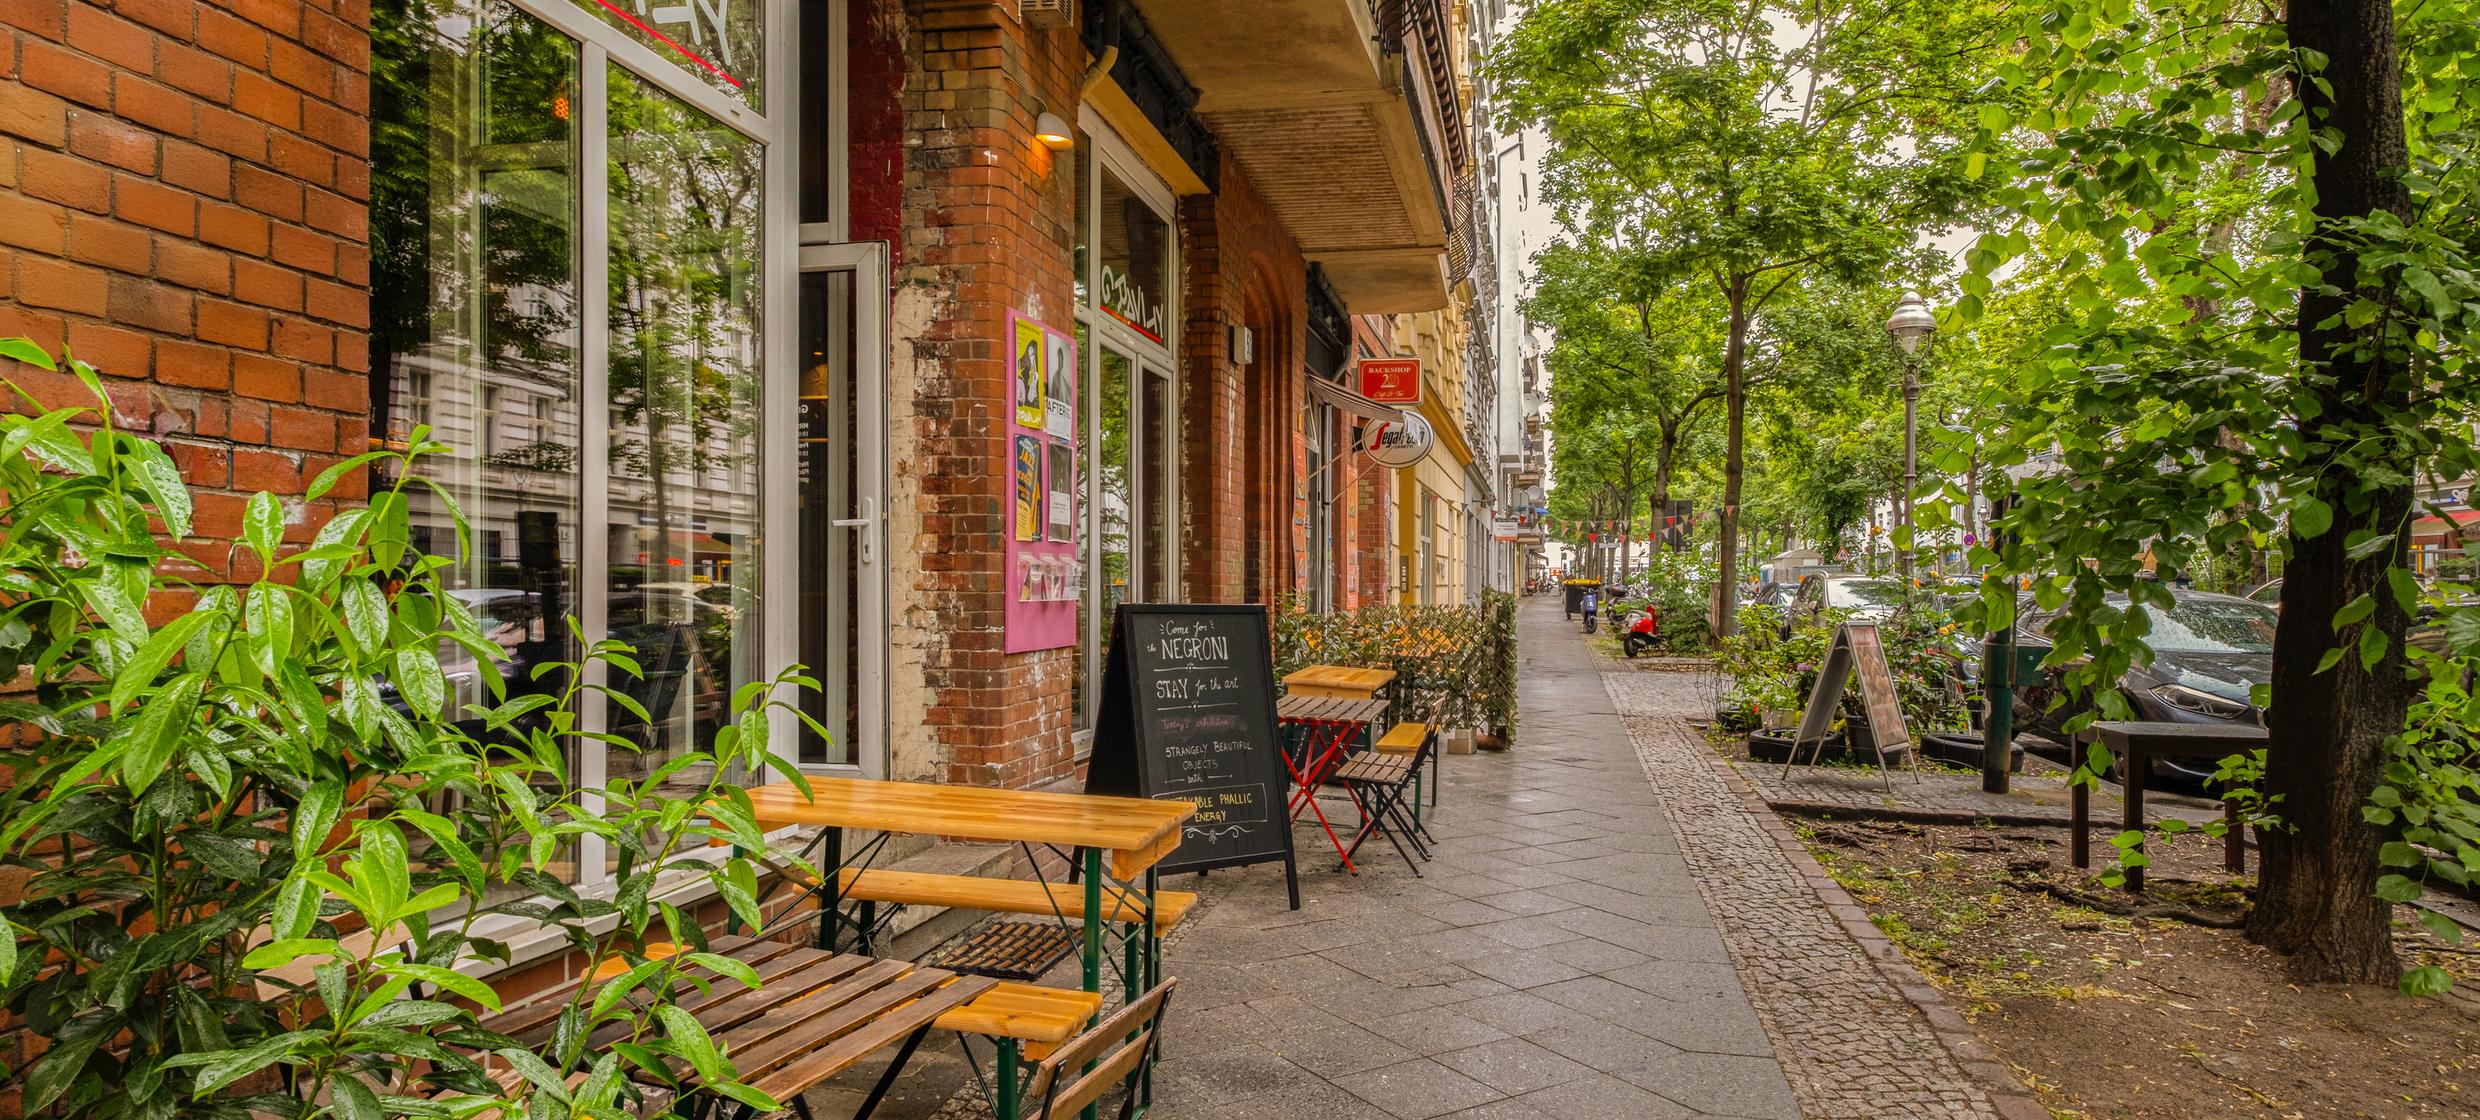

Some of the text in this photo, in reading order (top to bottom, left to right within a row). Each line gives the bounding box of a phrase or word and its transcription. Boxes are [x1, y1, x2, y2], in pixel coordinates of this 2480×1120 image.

[1166, 620, 1208, 637] Come for
[1147, 636, 1229, 661] the NEGRONI
[1156, 677, 1240, 699] STAY for the art
[1165, 741, 1253, 759] STRANGELY BEAUTIFUL
[1182, 760, 1218, 770] OBJECTS
[1219, 792, 1253, 805] PHALLIC
[1194, 809, 1226, 823] ENERGY
